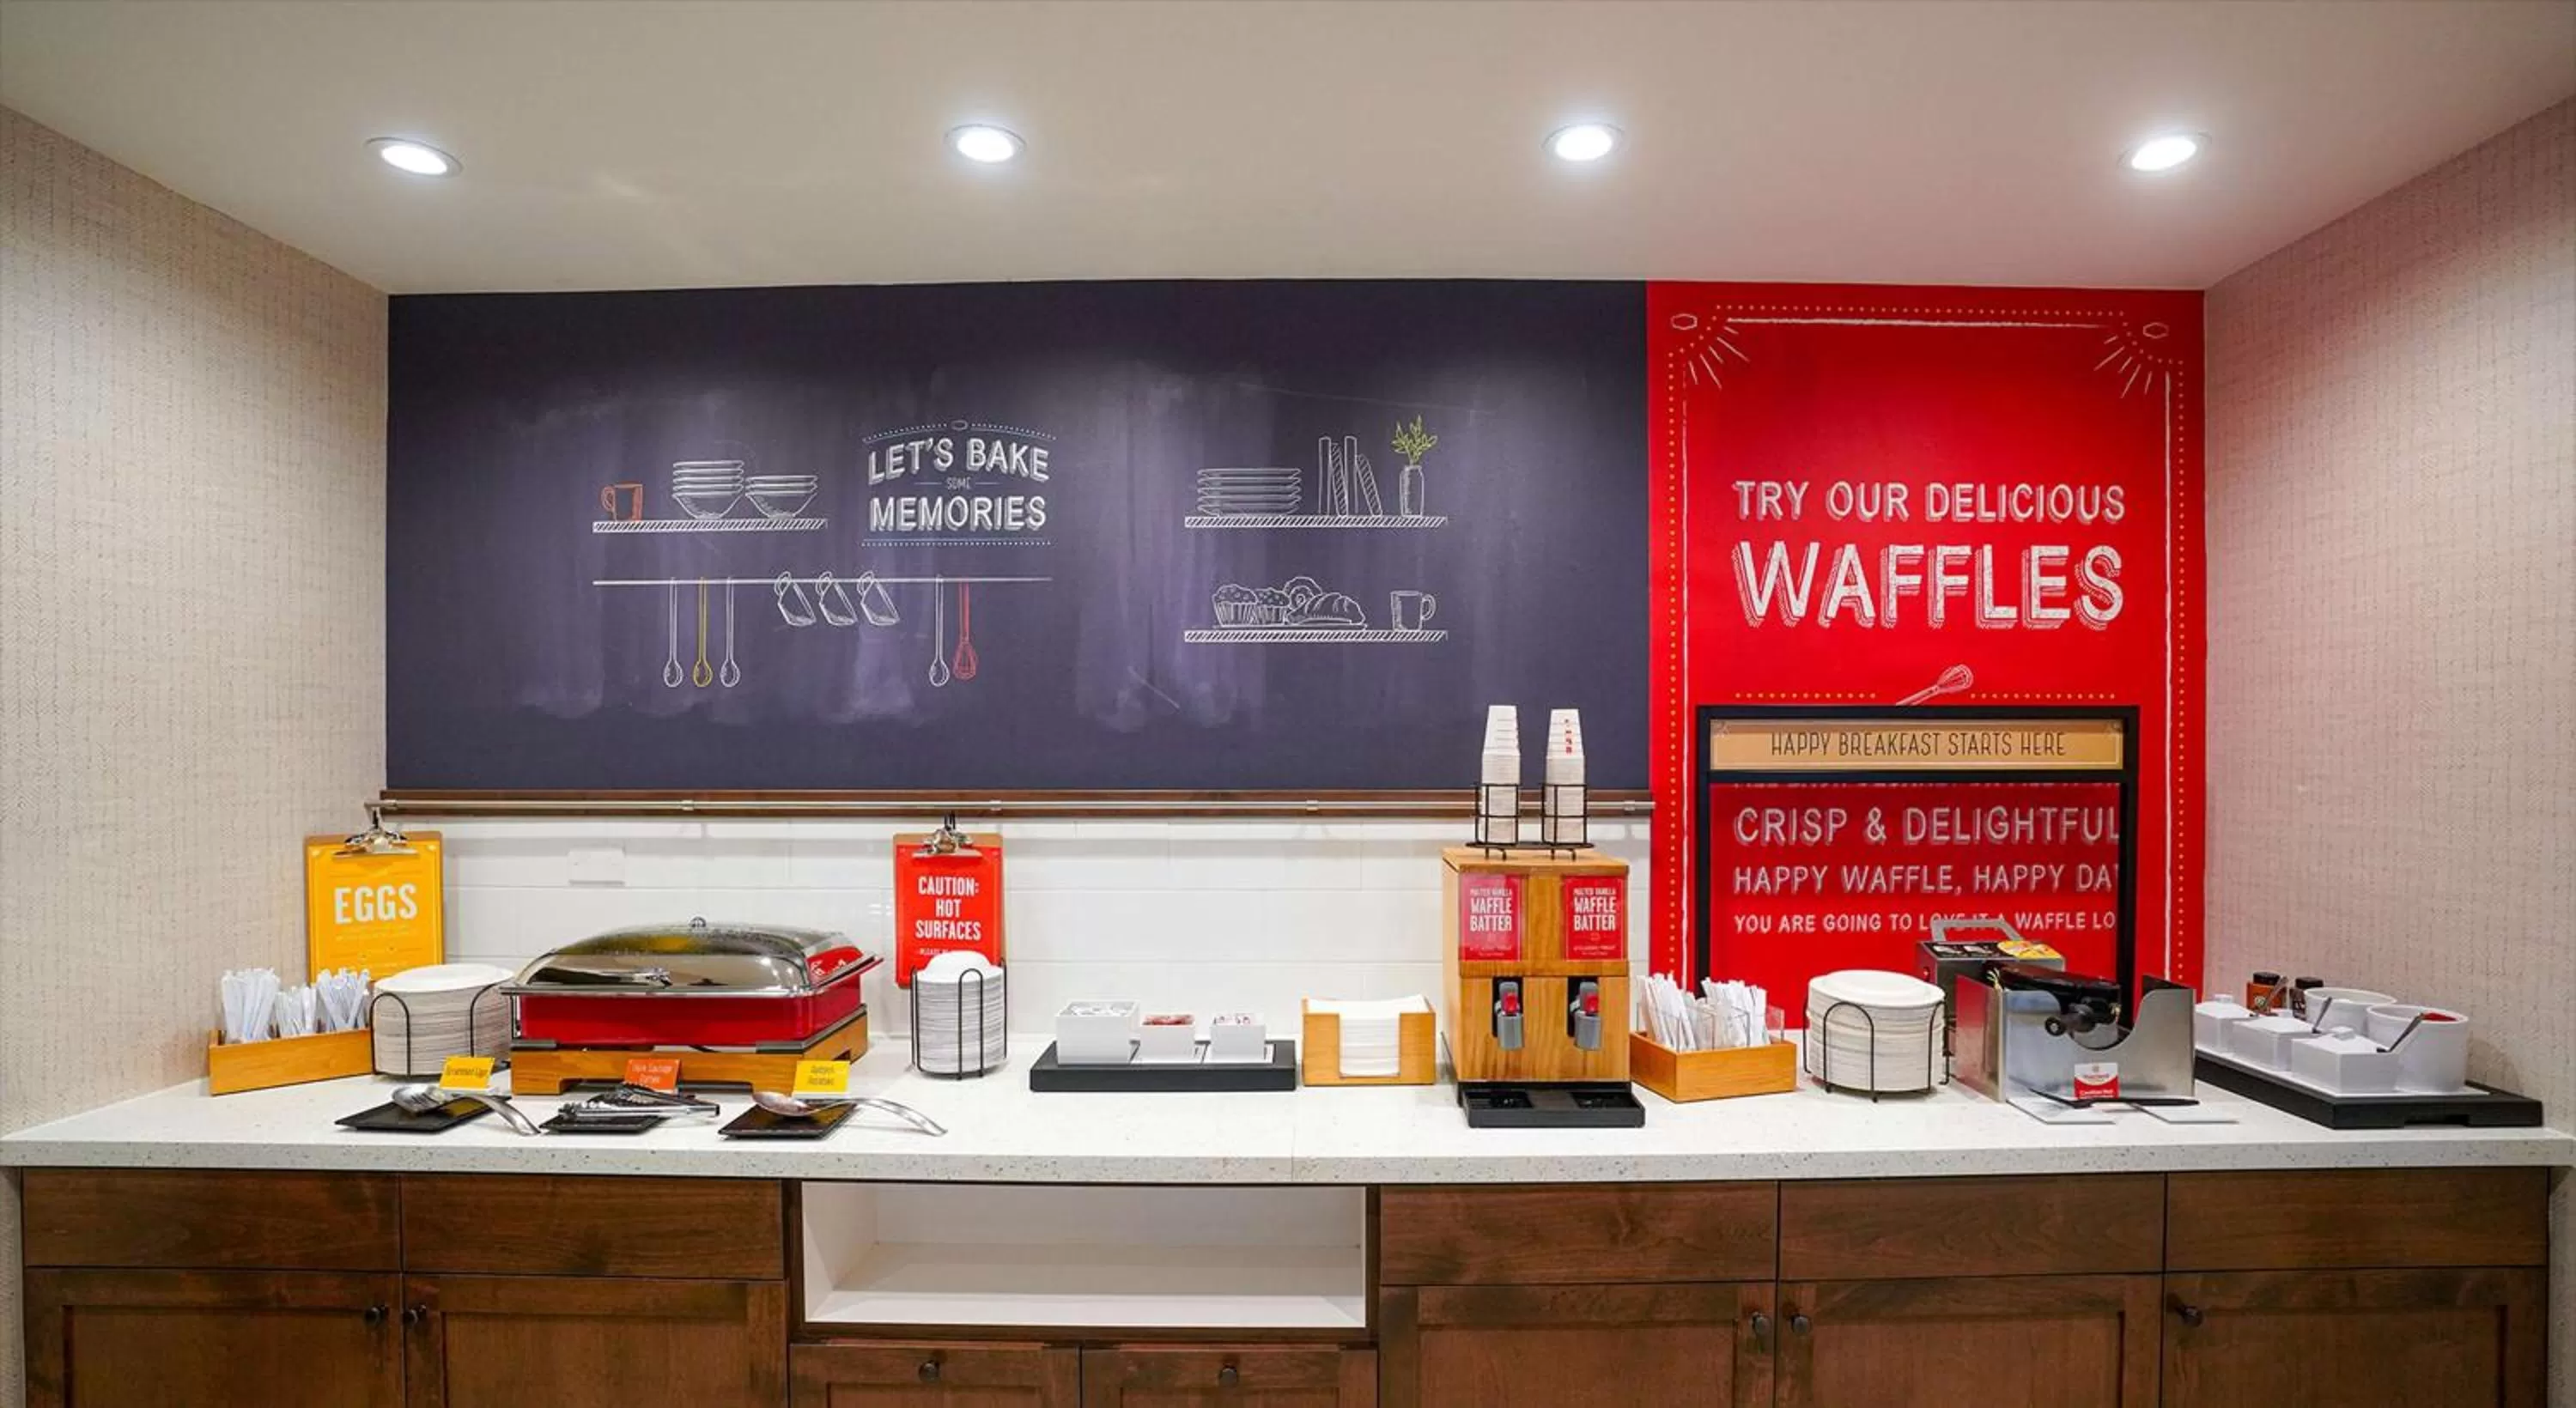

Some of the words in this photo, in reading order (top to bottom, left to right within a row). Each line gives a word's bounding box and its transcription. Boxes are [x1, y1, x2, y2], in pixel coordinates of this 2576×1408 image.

[868, 438, 954, 485] LET'S
[966, 438, 1050, 482] BAKE
[947, 476, 971, 489] SOME
[870, 495, 1048, 531] MEMORIES
[1733, 480, 1809, 520] TRY
[1826, 481, 1911, 522] OUR
[1925, 482, 2125, 525] DELICIOUS
[1731, 541, 2124, 629] WAFFLES
[1771, 731, 1831, 756] HAPPY
[1838, 731, 1941, 756] BREAKFAST
[1947, 731, 2013, 756] STARTS
[2020, 731, 2067, 756] HERE
[1735, 806, 1848, 847] CRISP
[1862, 806, 1887, 846] &
[1903, 805, 2119, 845] DELIGHTFUL
[917, 875, 980, 896] CAUTION:
[1734, 865, 1829, 895] HAPPY
[1841, 864, 1963, 896] WAFFLE,
[1974, 864, 2065, 893] HAPPY
[2075, 863, 2119, 893] DA
[333, 883, 418, 925] EGGS
[935, 898, 962, 918] HOT
[1470, 897, 1513, 914] WAFFLE
[1574, 896, 1617, 914] WAFFLE
[915, 919, 981, 941] SURFACES
[1470, 914, 1512, 932] BATTER
[1574, 914, 1616, 932] BATTER
[1734, 914, 1772, 934] YOU
[1778, 913, 1817, 933] ARE
[1823, 913, 1882, 932] GOING
[1889, 913, 1913, 932] TO
[2014, 911, 2087, 931] WAFFLE
